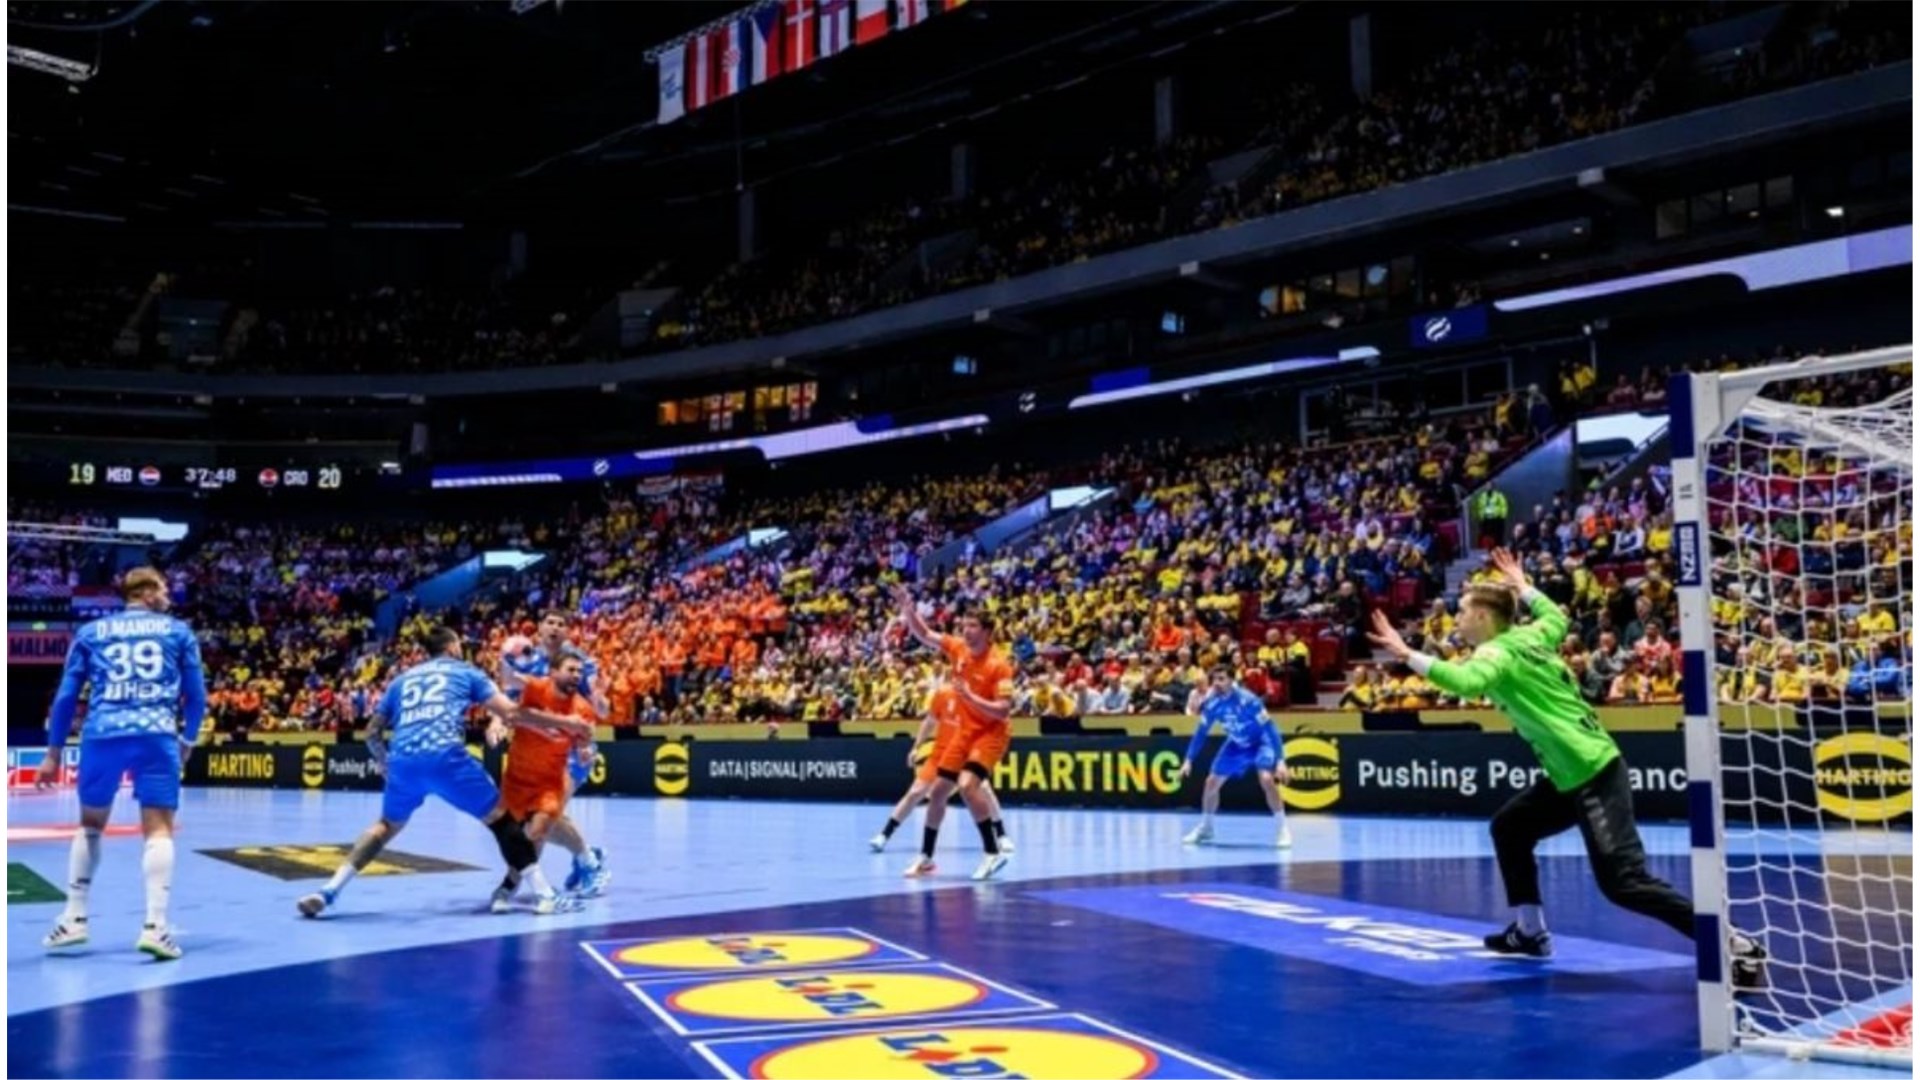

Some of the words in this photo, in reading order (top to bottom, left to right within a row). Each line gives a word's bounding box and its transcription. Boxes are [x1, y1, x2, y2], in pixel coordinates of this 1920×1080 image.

[70, 463, 95, 484] 19
[318, 468, 341, 488] 20
[103, 640, 163, 682] 39
[402, 673, 447, 708] 52
[208, 753, 274, 778] HARTING
[328, 758, 365, 778] Pushing
[993, 750, 1181, 793] HARTING
[1288, 766, 1339, 780] ARTING
[1358, 760, 1477, 796] Pushing
